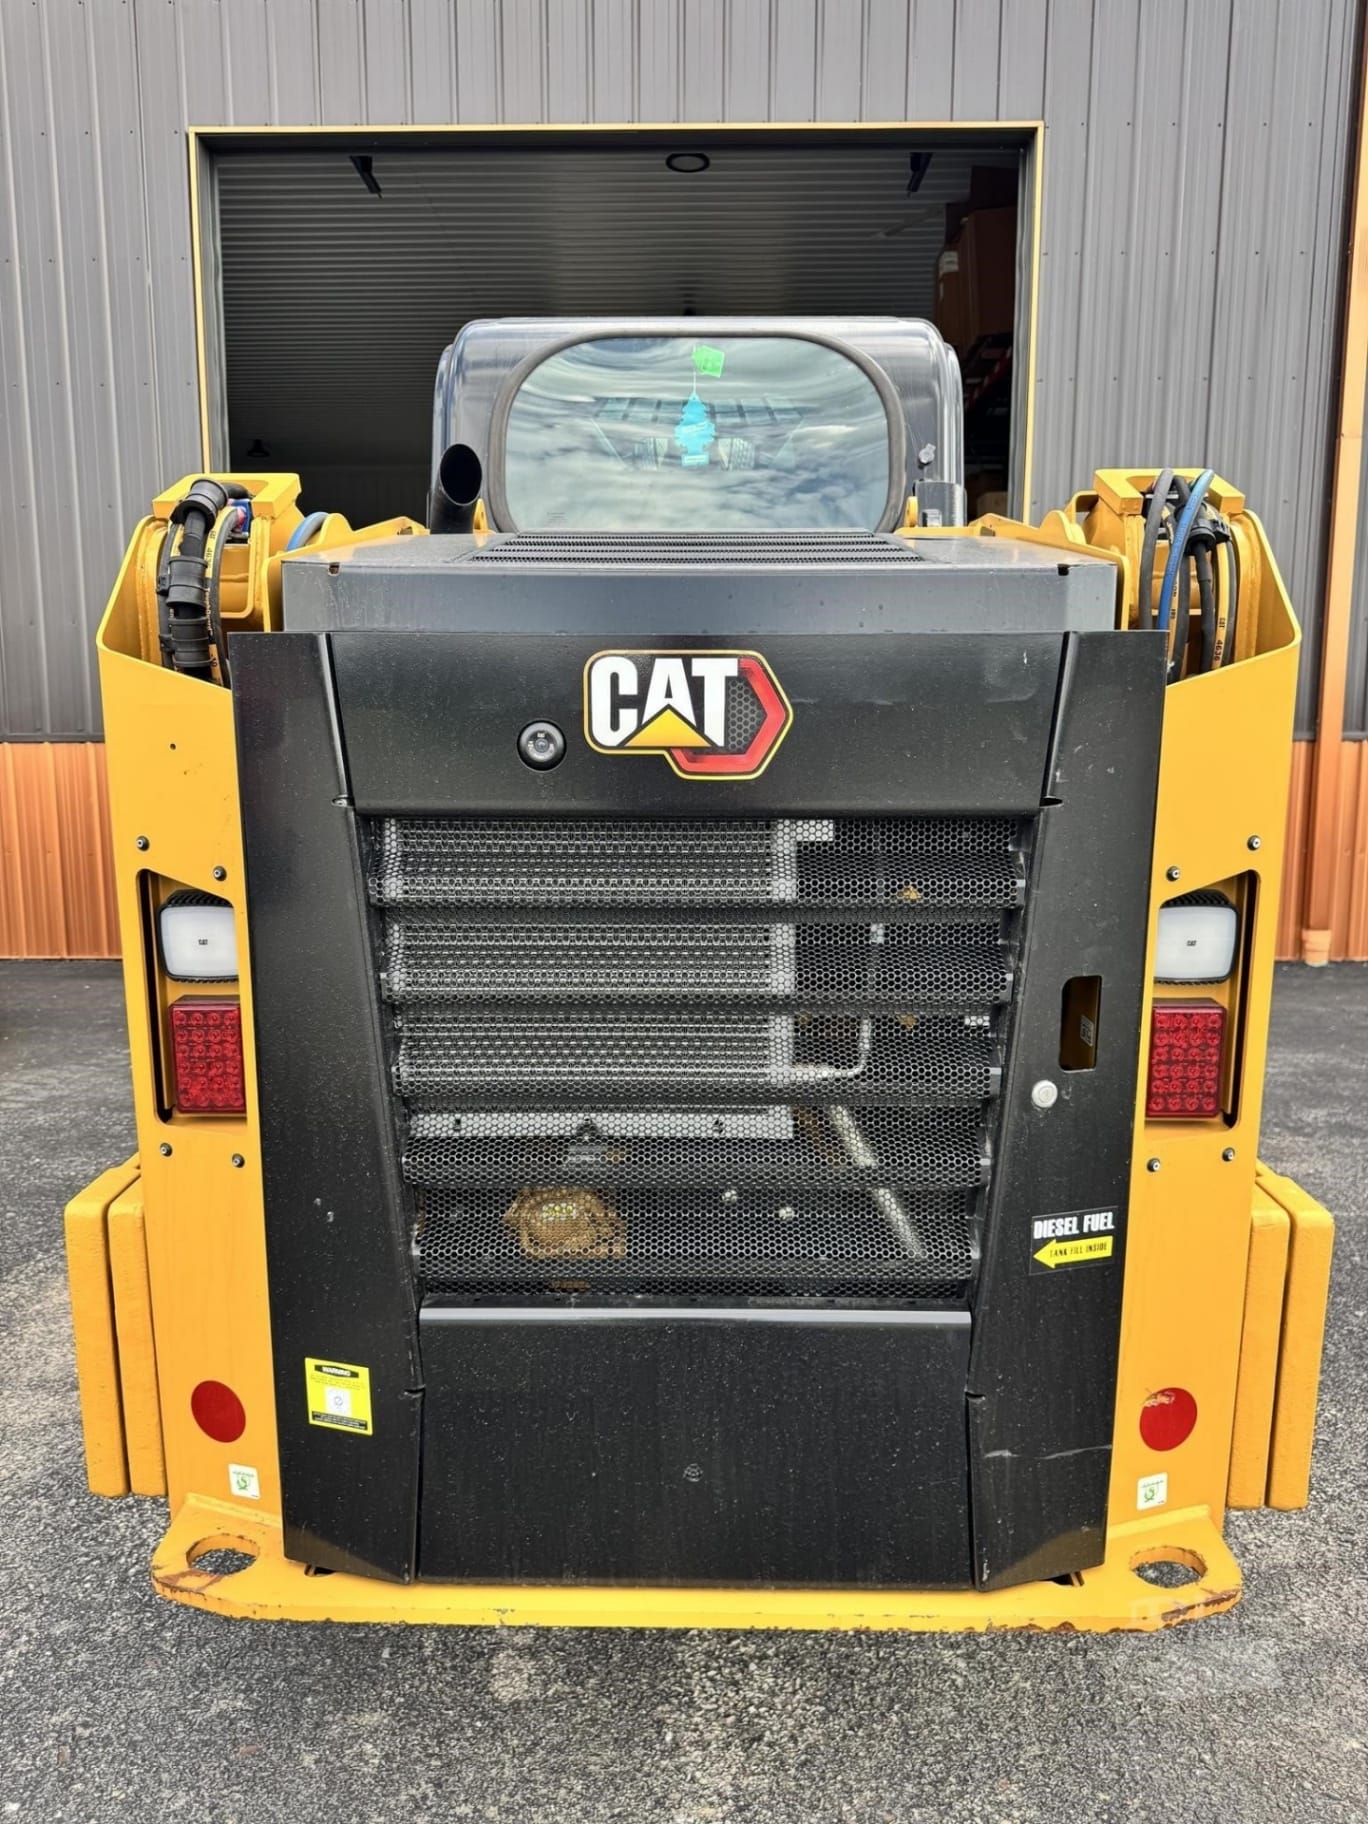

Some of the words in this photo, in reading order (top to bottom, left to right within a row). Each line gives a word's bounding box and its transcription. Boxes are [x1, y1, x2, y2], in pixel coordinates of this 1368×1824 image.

[590, 655, 738, 747] CAT
[1033, 1216, 1080, 1239] DIESEL
[1083, 1211, 1115, 1233] FUEL
